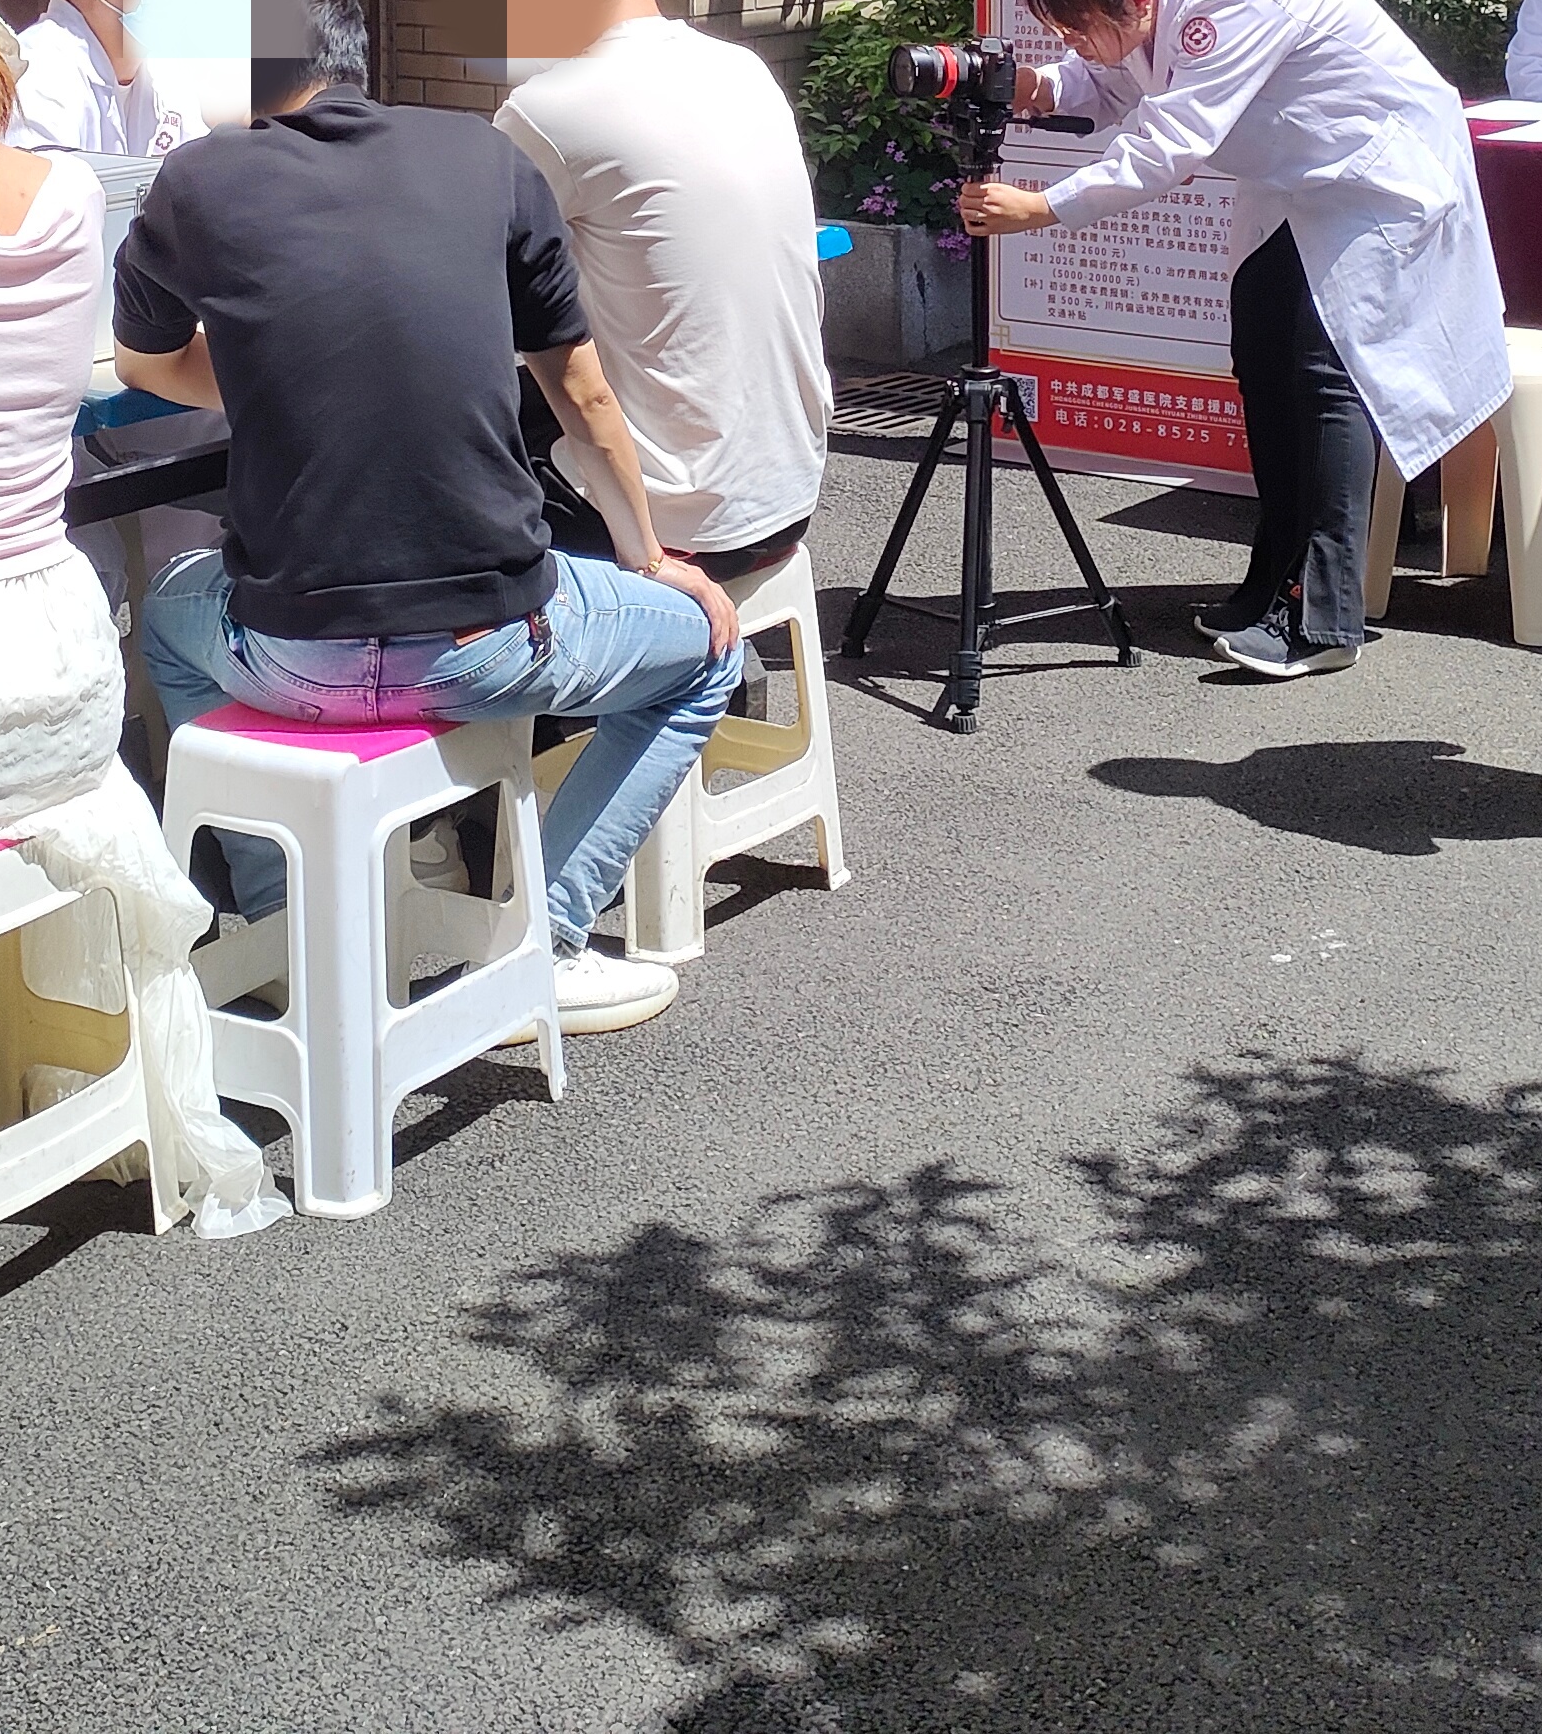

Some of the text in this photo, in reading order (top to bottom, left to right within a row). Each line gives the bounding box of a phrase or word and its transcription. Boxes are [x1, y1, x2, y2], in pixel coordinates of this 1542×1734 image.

[1014, 25, 1039, 35] 2026
[1186, 228, 1207, 239] 380
[1103, 234, 1141, 246] MTSNT
[1081, 244, 1107, 256] 2600
[1049, 254, 1075, 266] 2026
[1143, 265, 1162, 275] 6.0
[1166, 266, 1230, 283] 治疗费用减免
[1047, 294, 1057, 304] 报
[1061, 296, 1080, 306] 500
[1047, 307, 1087, 321] 交通补贴
[1050, 379, 1245, 417] 中共成都军盛医院支部援助
